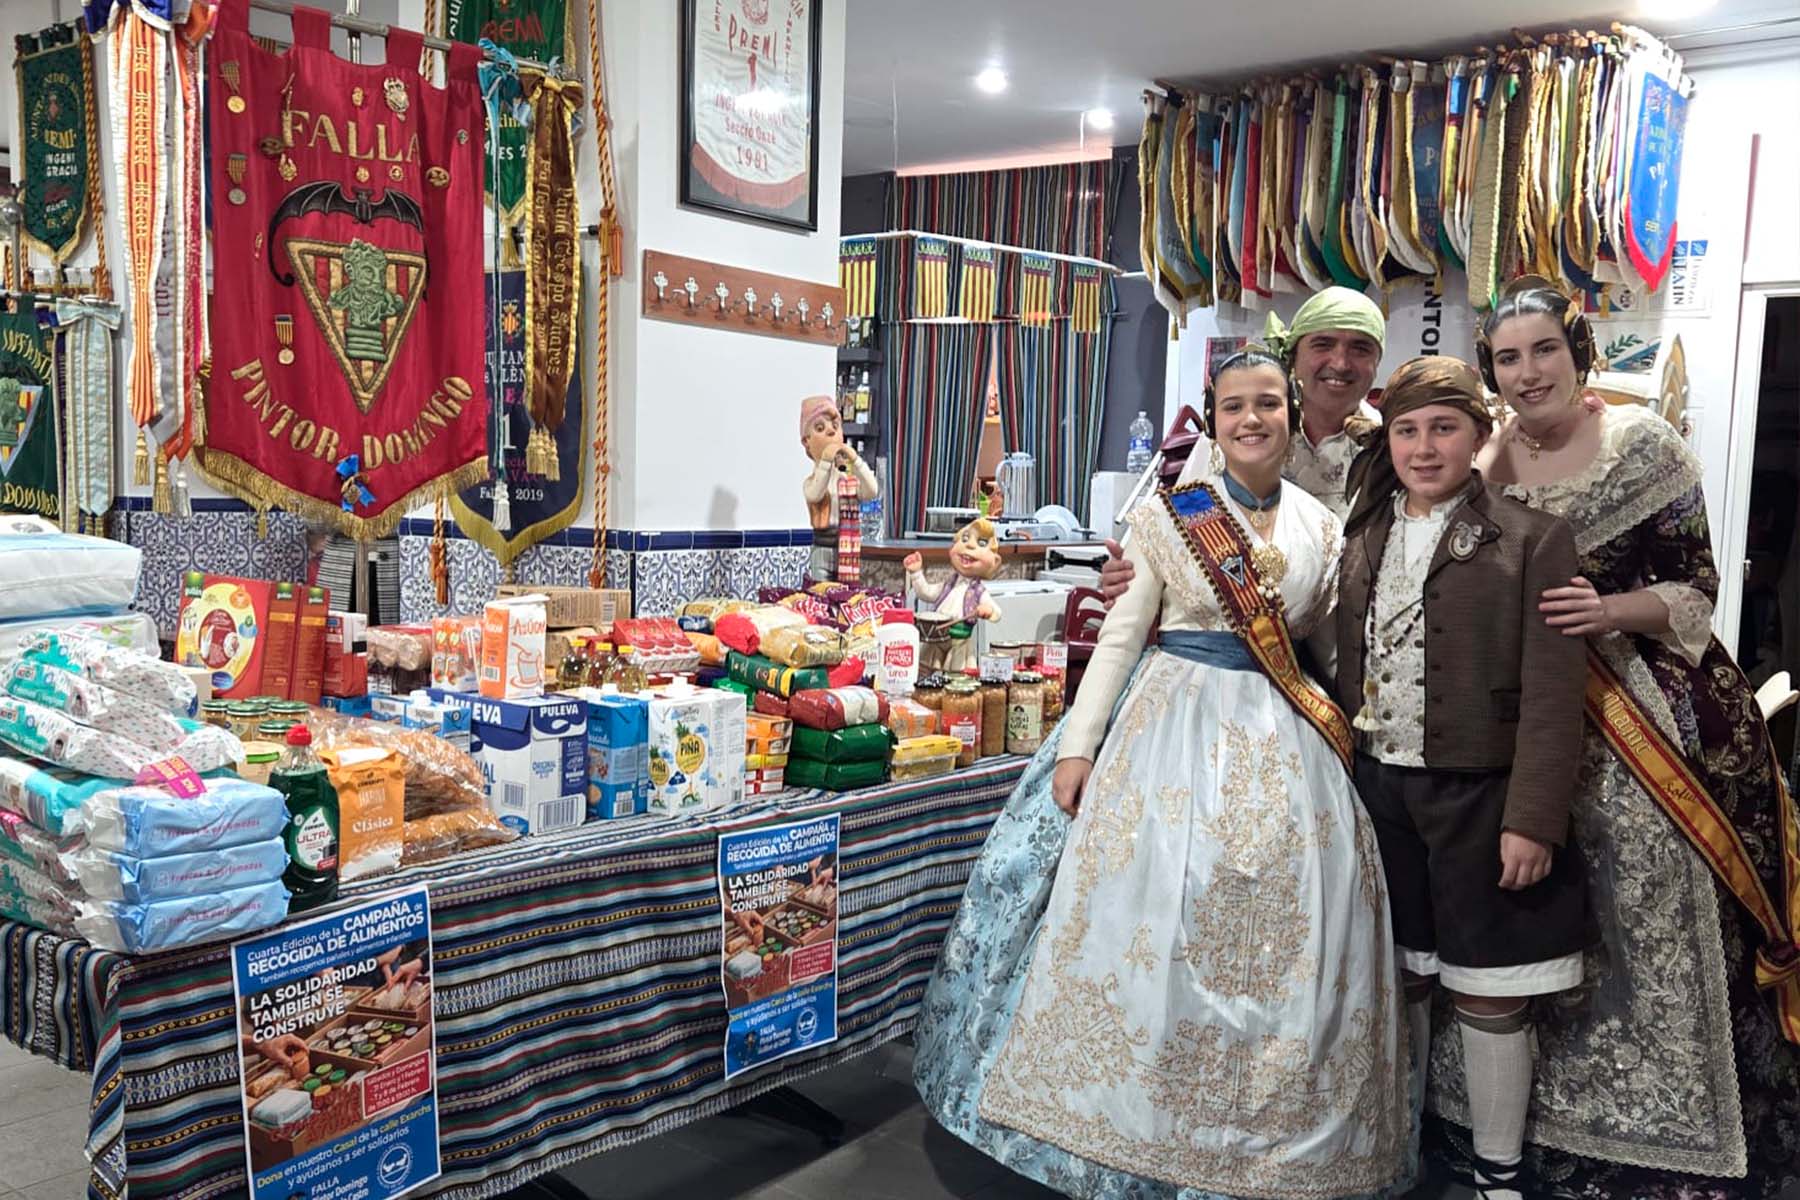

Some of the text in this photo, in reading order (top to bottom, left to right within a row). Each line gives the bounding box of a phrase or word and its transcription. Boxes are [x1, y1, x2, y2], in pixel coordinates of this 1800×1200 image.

[729, 13, 777, 69] PREMI
[284, 109, 421, 166] FALLA
[231, 357, 343, 466] PINTOR
[363, 375, 473, 470] DOMINGO
[515, 488, 544, 501] 2019
[540, 703, 579, 718] PULEVA
[680, 737, 700, 757] PIÑA
[297, 829, 332, 844] ULTRA
[352, 815, 395, 833] Clásica
[789, 821, 829, 841] CAMPAÑA
[727, 846, 780, 864] RECOGIDA
[780, 841, 793, 854] DE
[793, 831, 836, 848] ALIMENTOS
[728, 862, 809, 889] LA SOLIDARIDAD
[775, 879, 788, 890] SE
[731, 891, 788, 914] CONSTRUYE
[247, 900, 423, 961] Cuarta Edición de la CAMPAÑA de
[248, 910, 424, 977] RECOGIDA DE ALIMENTOS
[250, 957, 377, 1012] LA SOLIDARIDAD
[259, 969, 290, 985] También
[250, 984, 344, 1027] TAMBIÉN SE
[252, 1001, 345, 1044] CONSTRUYE
[256, 1169, 284, 1189] Dona
[284, 1164, 297, 1176] en
[297, 1150, 333, 1169] nuestro
[333, 1136, 358, 1155] Casal
[358, 1131, 370, 1144] de
[370, 1127, 379, 1140] la
[399, 1103, 432, 1124] Exarchs
[287, 1178, 295, 1190] y
[295, 1157, 343, 1185] ayúdanos
[351, 1147, 366, 1159] ser
[367, 1126, 410, 1151] solidarios
[311, 1176, 339, 1195] FALLA
[335, 1175, 369, 1197] Domingo
